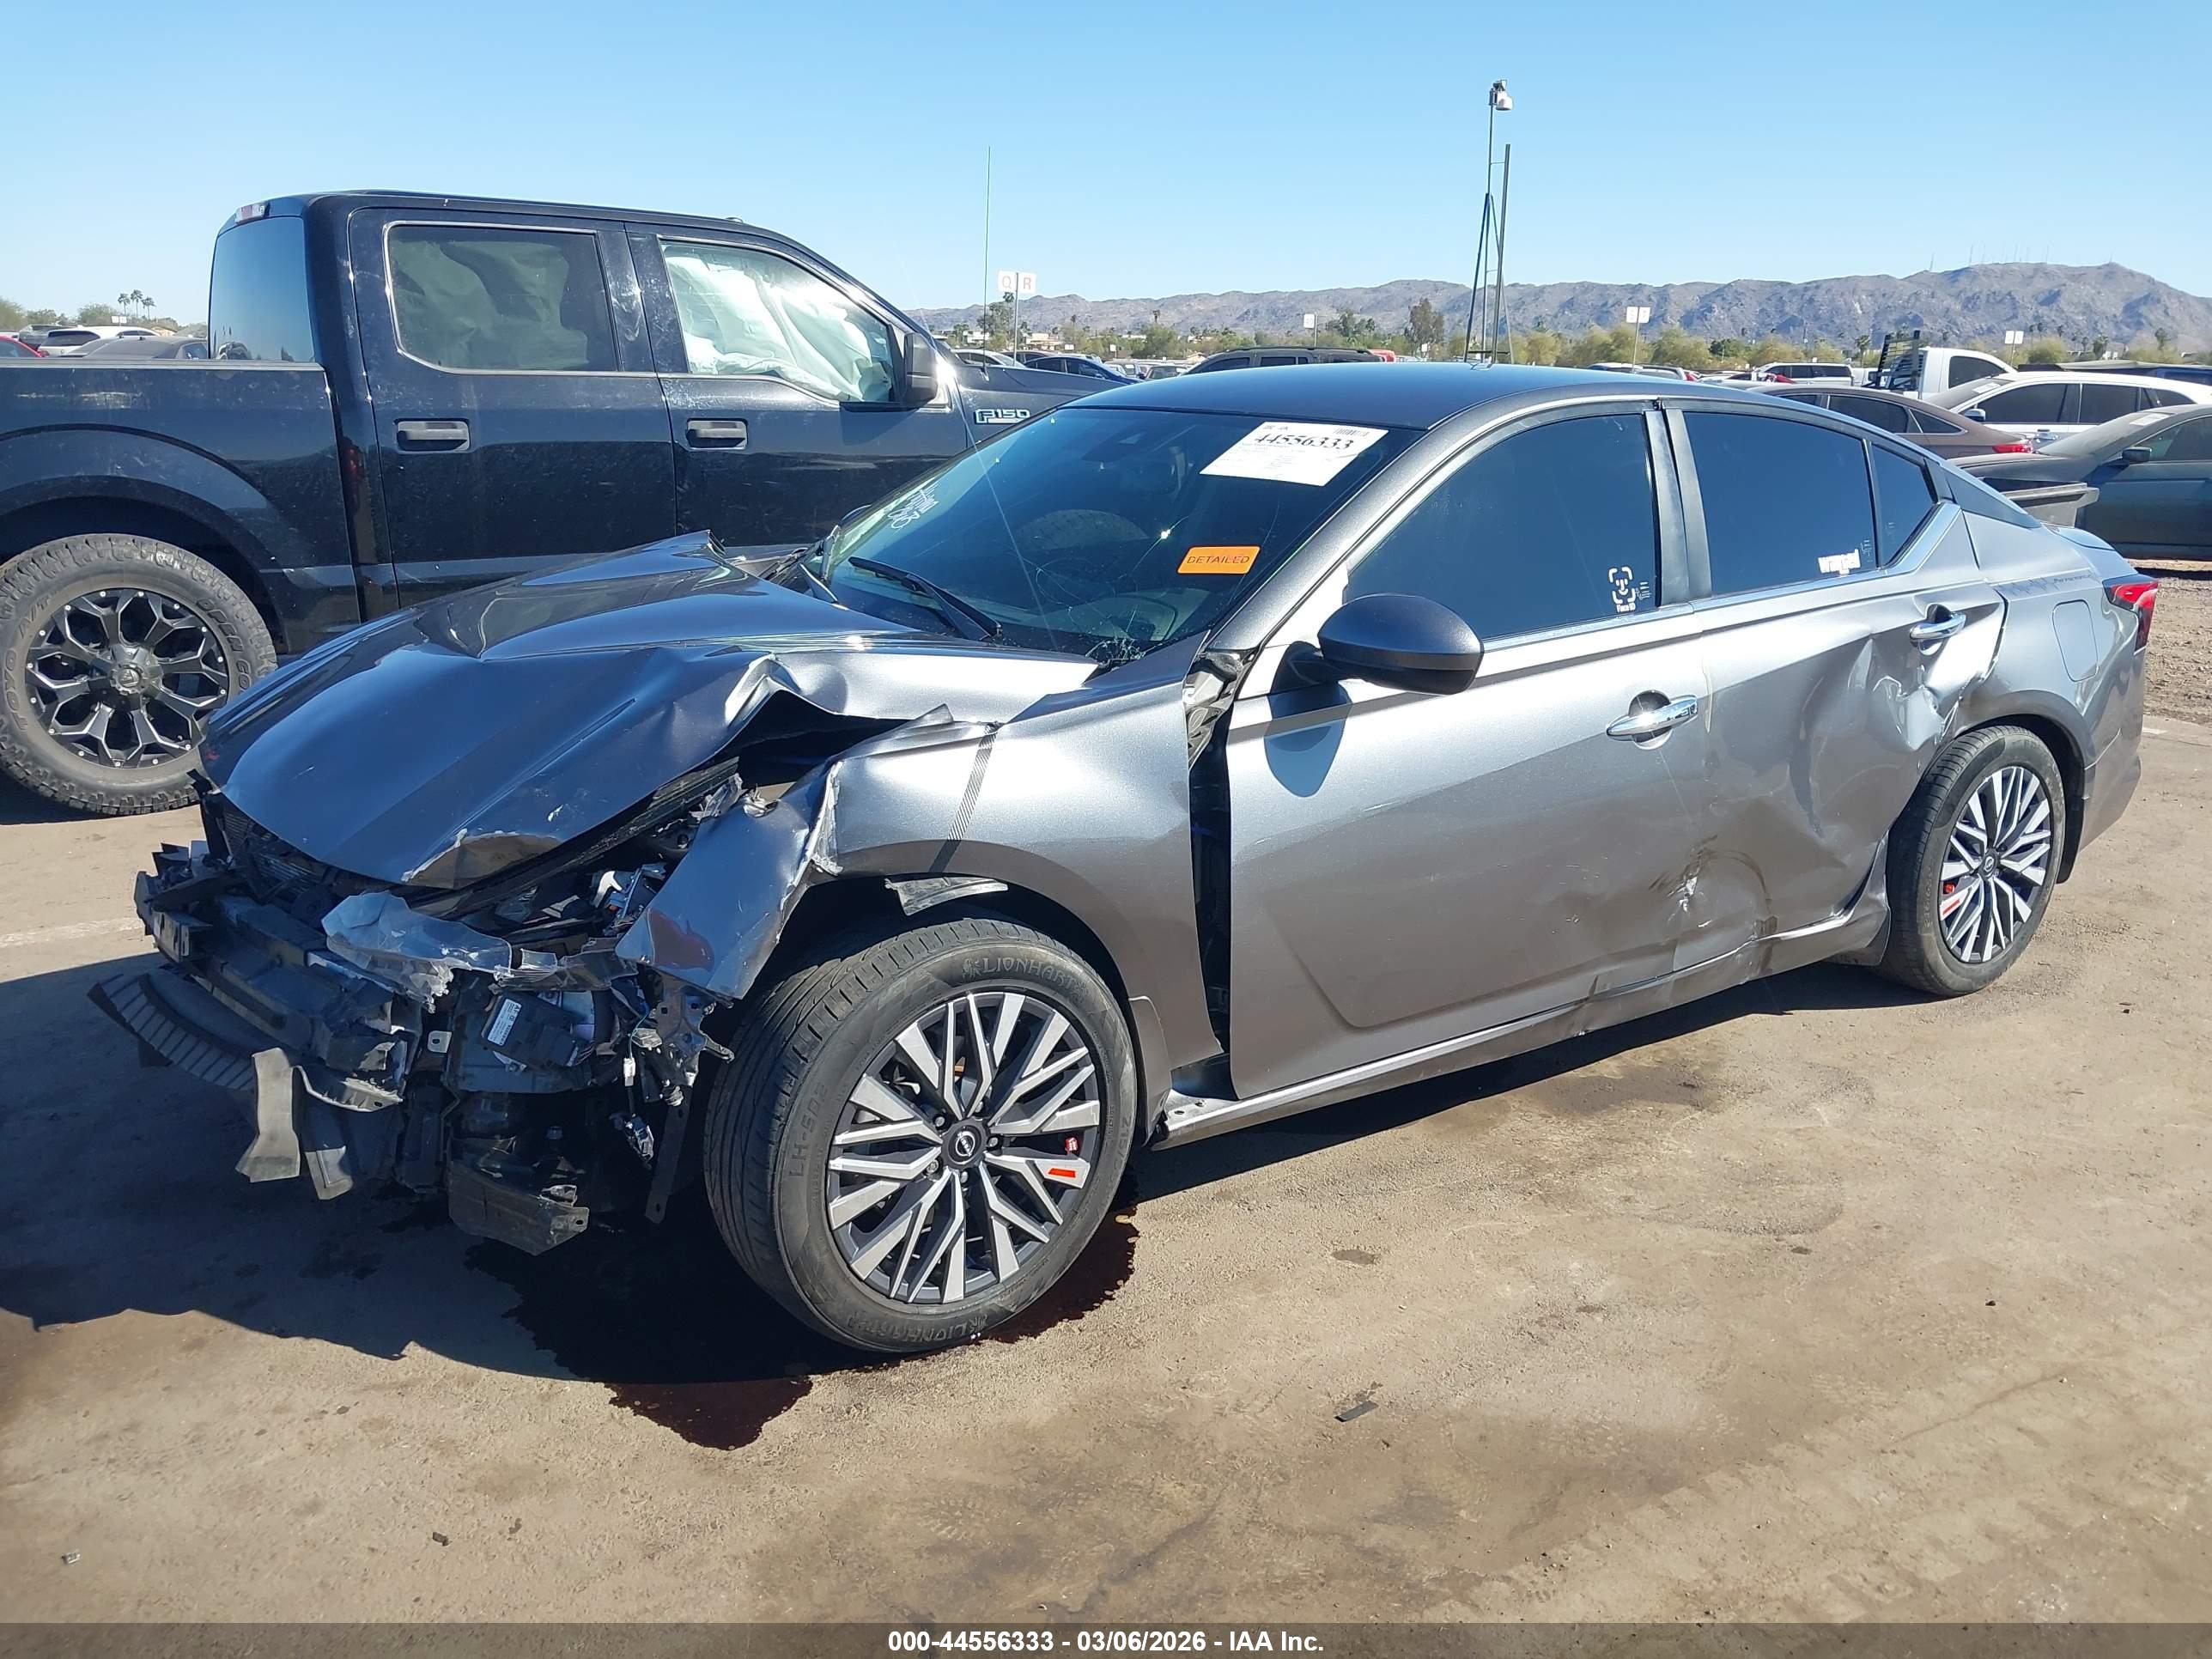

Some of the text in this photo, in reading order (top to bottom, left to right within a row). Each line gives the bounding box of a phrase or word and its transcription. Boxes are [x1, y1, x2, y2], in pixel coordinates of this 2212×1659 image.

[1002, 275, 1012, 290] Q
[1023, 276, 1032, 291] R
[1255, 433, 1354, 450] 44556333
[1186, 556, 1250, 564] DETAILED
[4, 648, 28, 731] TOYO
[982, 957, 1074, 989] LIONHART
